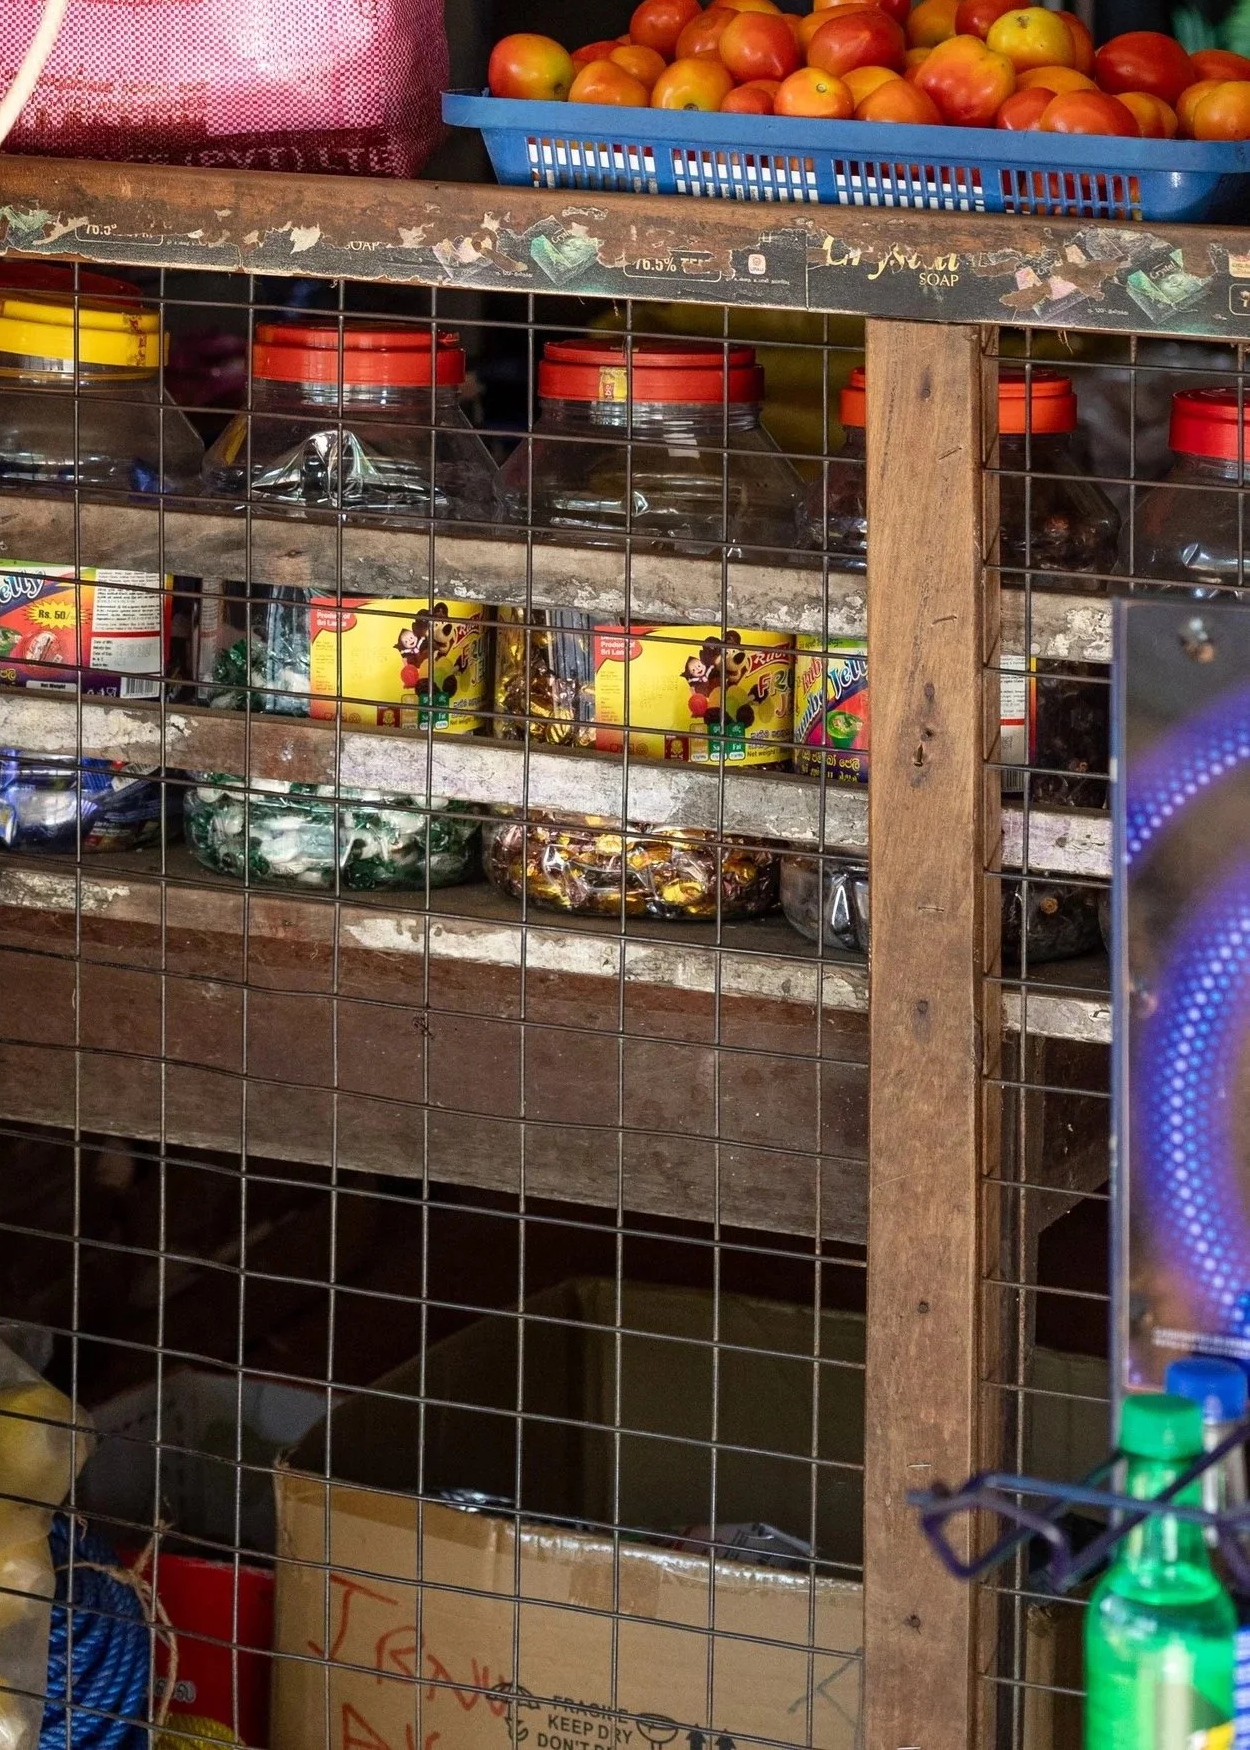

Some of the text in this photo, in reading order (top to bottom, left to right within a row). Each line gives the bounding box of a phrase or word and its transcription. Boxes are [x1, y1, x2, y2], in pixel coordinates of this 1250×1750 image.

[634, 256, 677, 272] 76.5%
[918, 272, 959, 287] SOAP
[38, 609, 52, 620] Rs.
[828, 652, 868, 701] Jell
[731, 742, 742, 750] Fat
[747, 750, 758, 758] Net
[547, 1714, 594, 1737] KEEP
